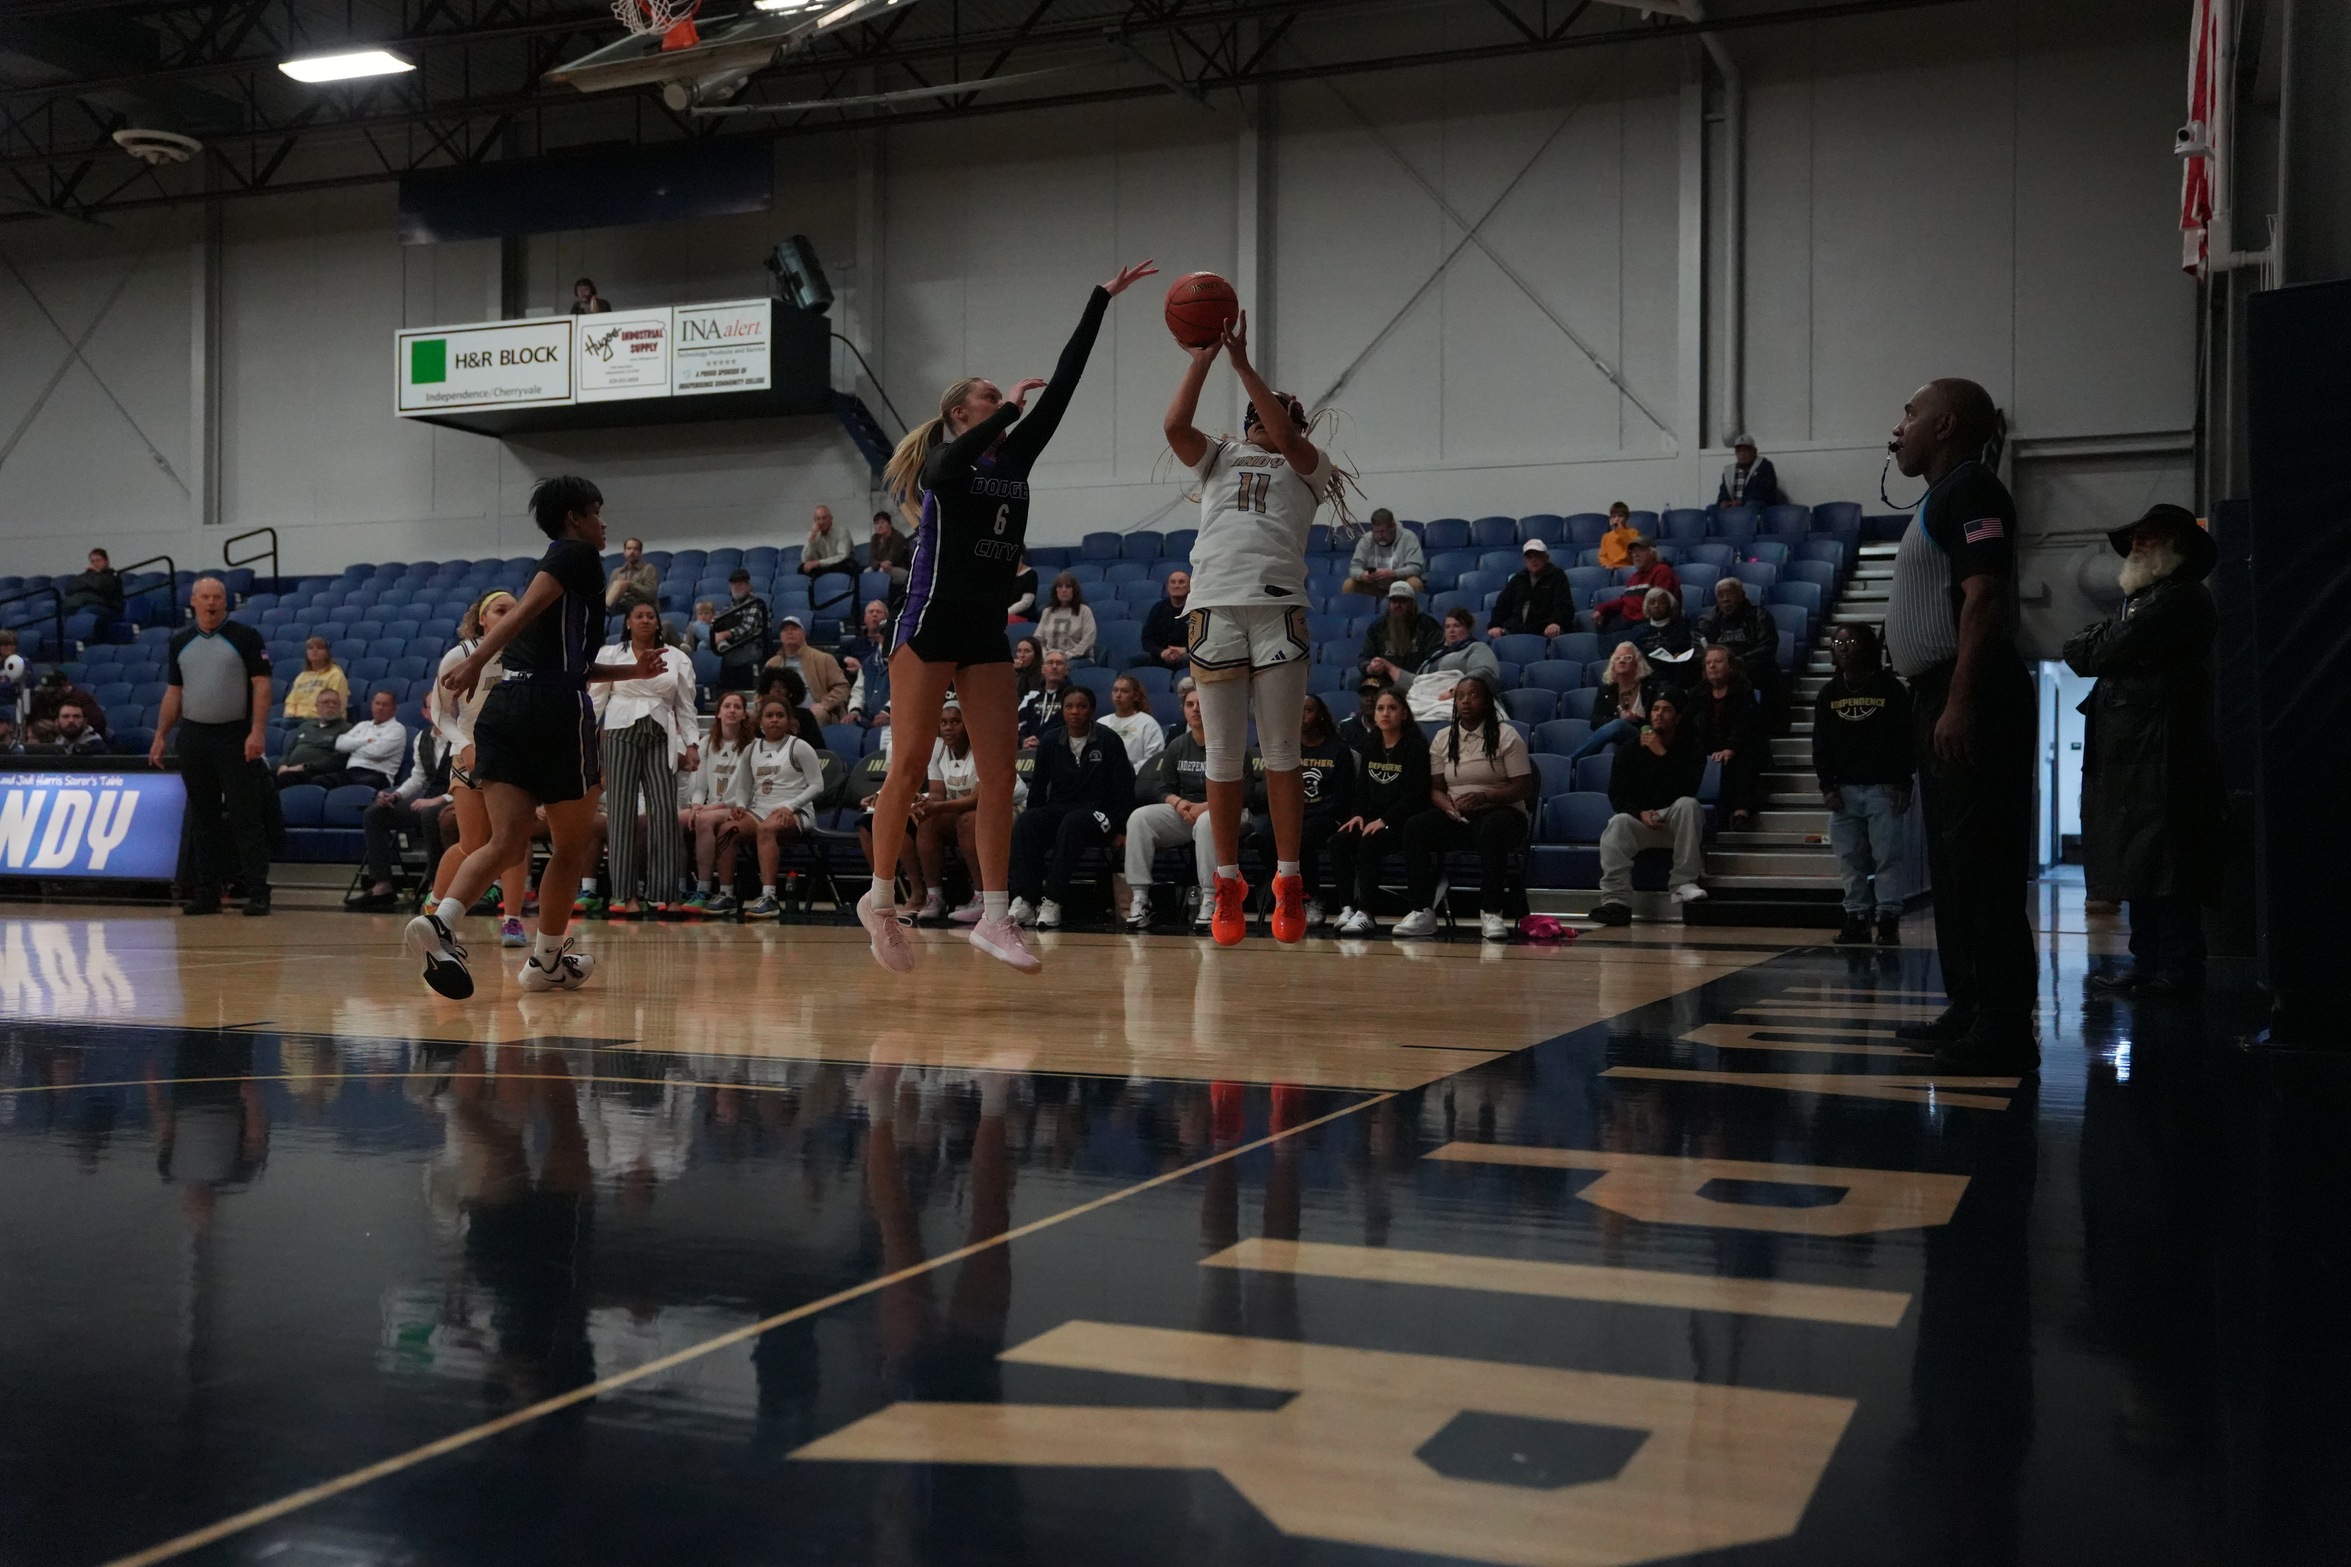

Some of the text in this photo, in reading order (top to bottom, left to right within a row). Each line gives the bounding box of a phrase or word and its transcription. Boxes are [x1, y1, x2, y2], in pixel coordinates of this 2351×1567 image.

[621, 328, 664, 342] INDUSTRIAL
[630, 341, 659, 354] SUPPLY
[455, 346, 558, 369] H&R BLOCK
[745, 377, 765, 385] COLLEGE
[1230, 455, 1286, 469] INDY
[970, 477, 1029, 500] DODGE
[1238, 471, 1271, 513] 11
[993, 504, 1009, 535] 6
[974, 538, 1019, 562] CITY
[99, 775, 124, 787] Table
